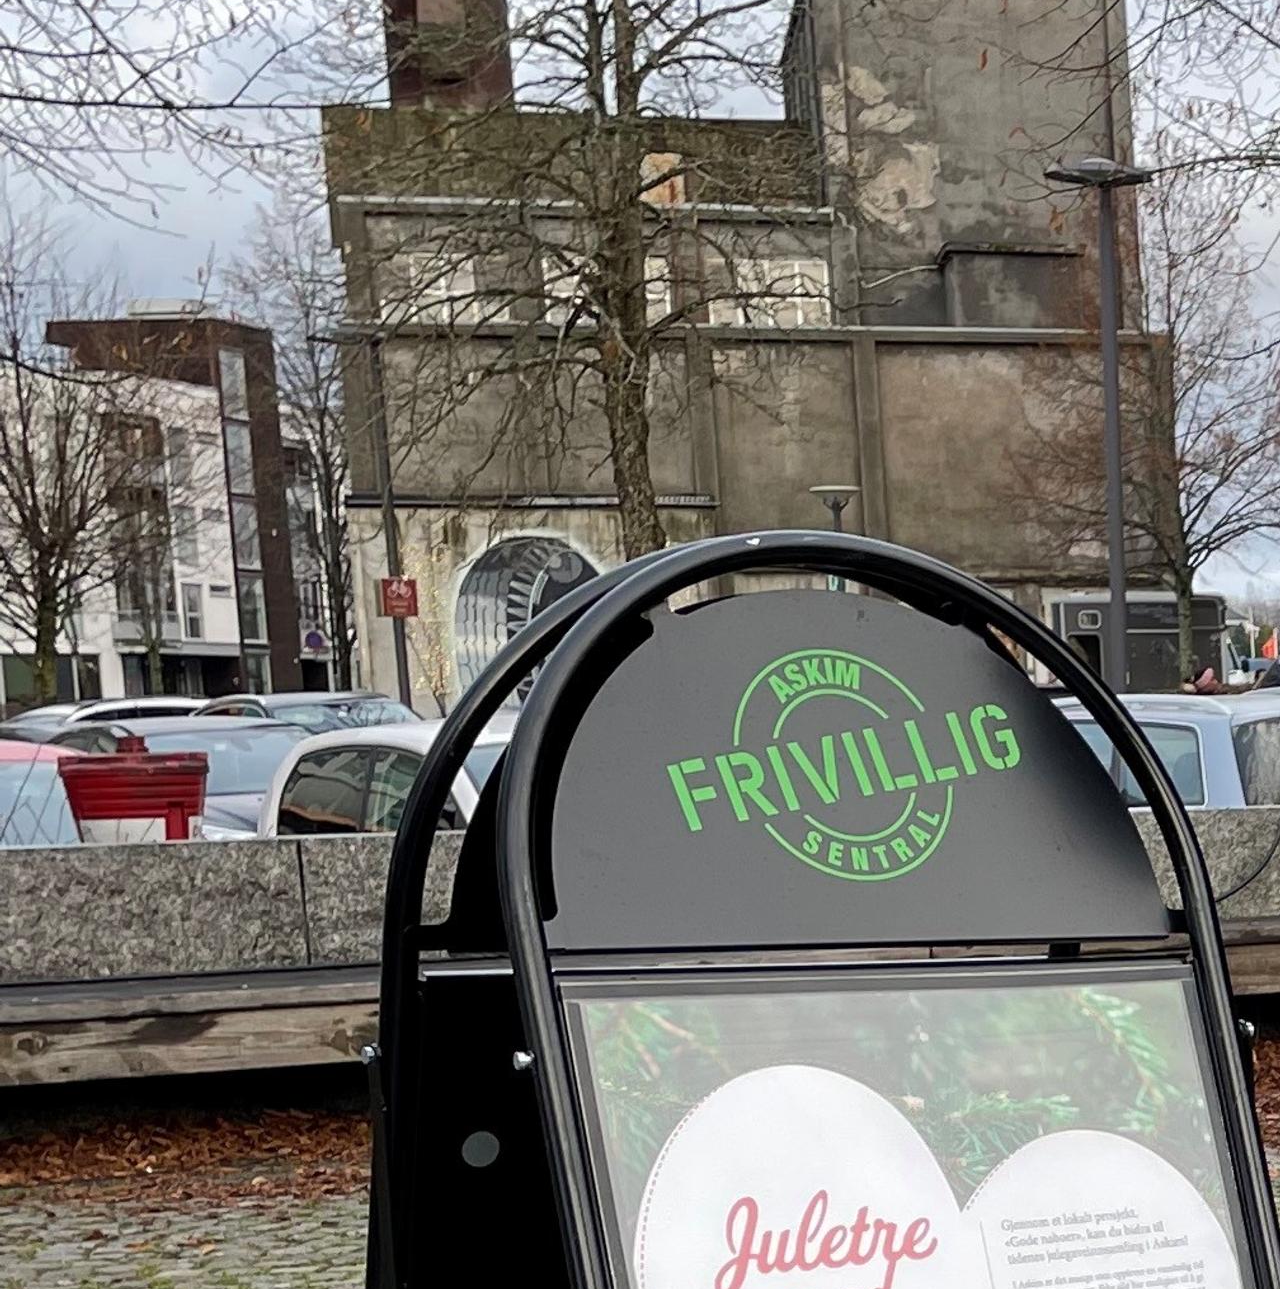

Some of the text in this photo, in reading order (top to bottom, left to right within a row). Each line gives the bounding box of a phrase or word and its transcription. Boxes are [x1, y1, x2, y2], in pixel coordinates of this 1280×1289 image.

[768, 658, 861, 704] ASKIM
[667, 703, 1022, 832] FRIVILLIG
[802, 808, 940, 871] SENTRAL
[1108, 1225, 1122, 1237] du
[1152, 1220, 1164, 1233] til
